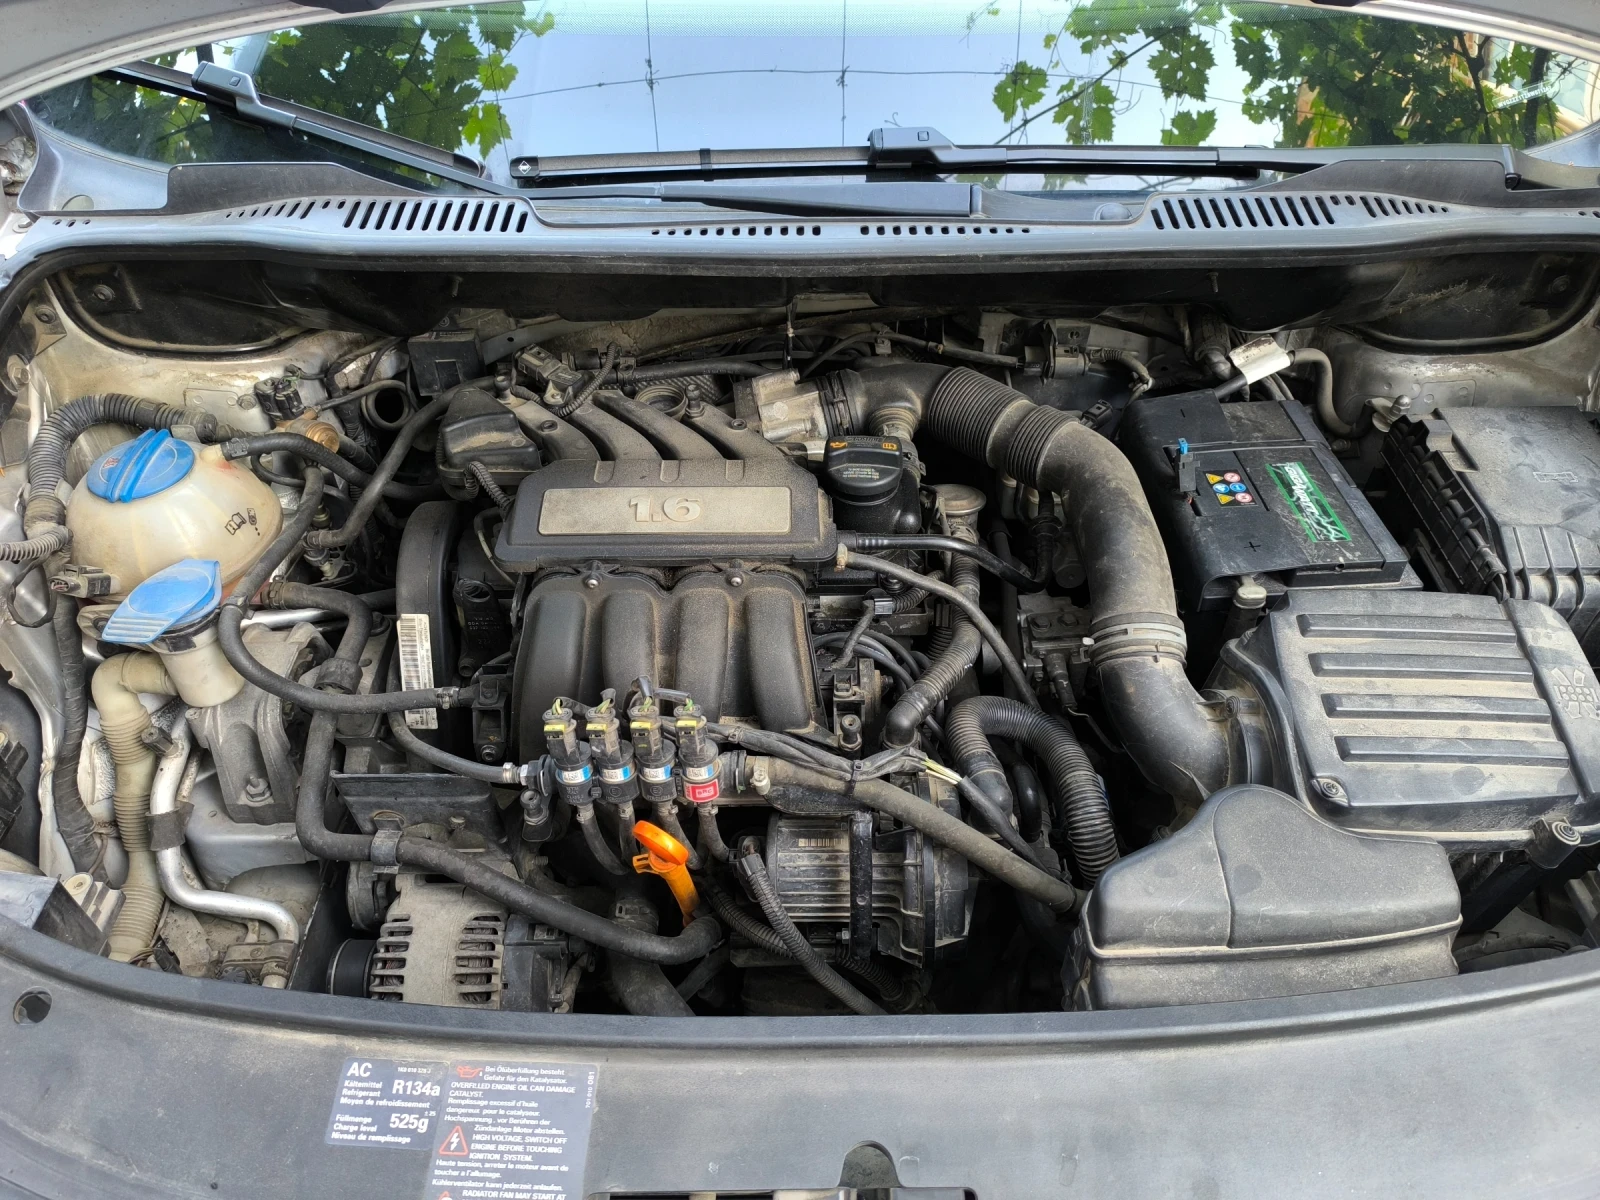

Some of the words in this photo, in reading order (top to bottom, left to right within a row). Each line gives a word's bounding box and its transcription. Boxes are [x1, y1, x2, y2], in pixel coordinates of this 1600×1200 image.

[628, 497, 700, 522] 1.6
[347, 1062, 372, 1078] AC
[344, 1080, 382, 1088] Kältemittel
[392, 1080, 440, 1096] R134a
[451, 1082, 490, 1090] OVERFILLED
[342, 1088, 381, 1098] Refrigerant
[340, 1097, 364, 1106] Moyen
[376, 1099, 430, 1108] refroidissement
[448, 1097, 488, 1106] Remplissage
[446, 1106, 480, 1114] dangereux
[336, 1114, 372, 1124] Füllmenge
[390, 1113, 429, 1133] 525g
[334, 1123, 358, 1132] Charge
[474, 1124, 512, 1133] Zündanlage
[331, 1132, 356, 1140] Niveau
[368, 1135, 411, 1144] remplissage
[526, 1146, 563, 1154] TOUCHING
[432, 1178, 485, 1187] Kühlerventilator
